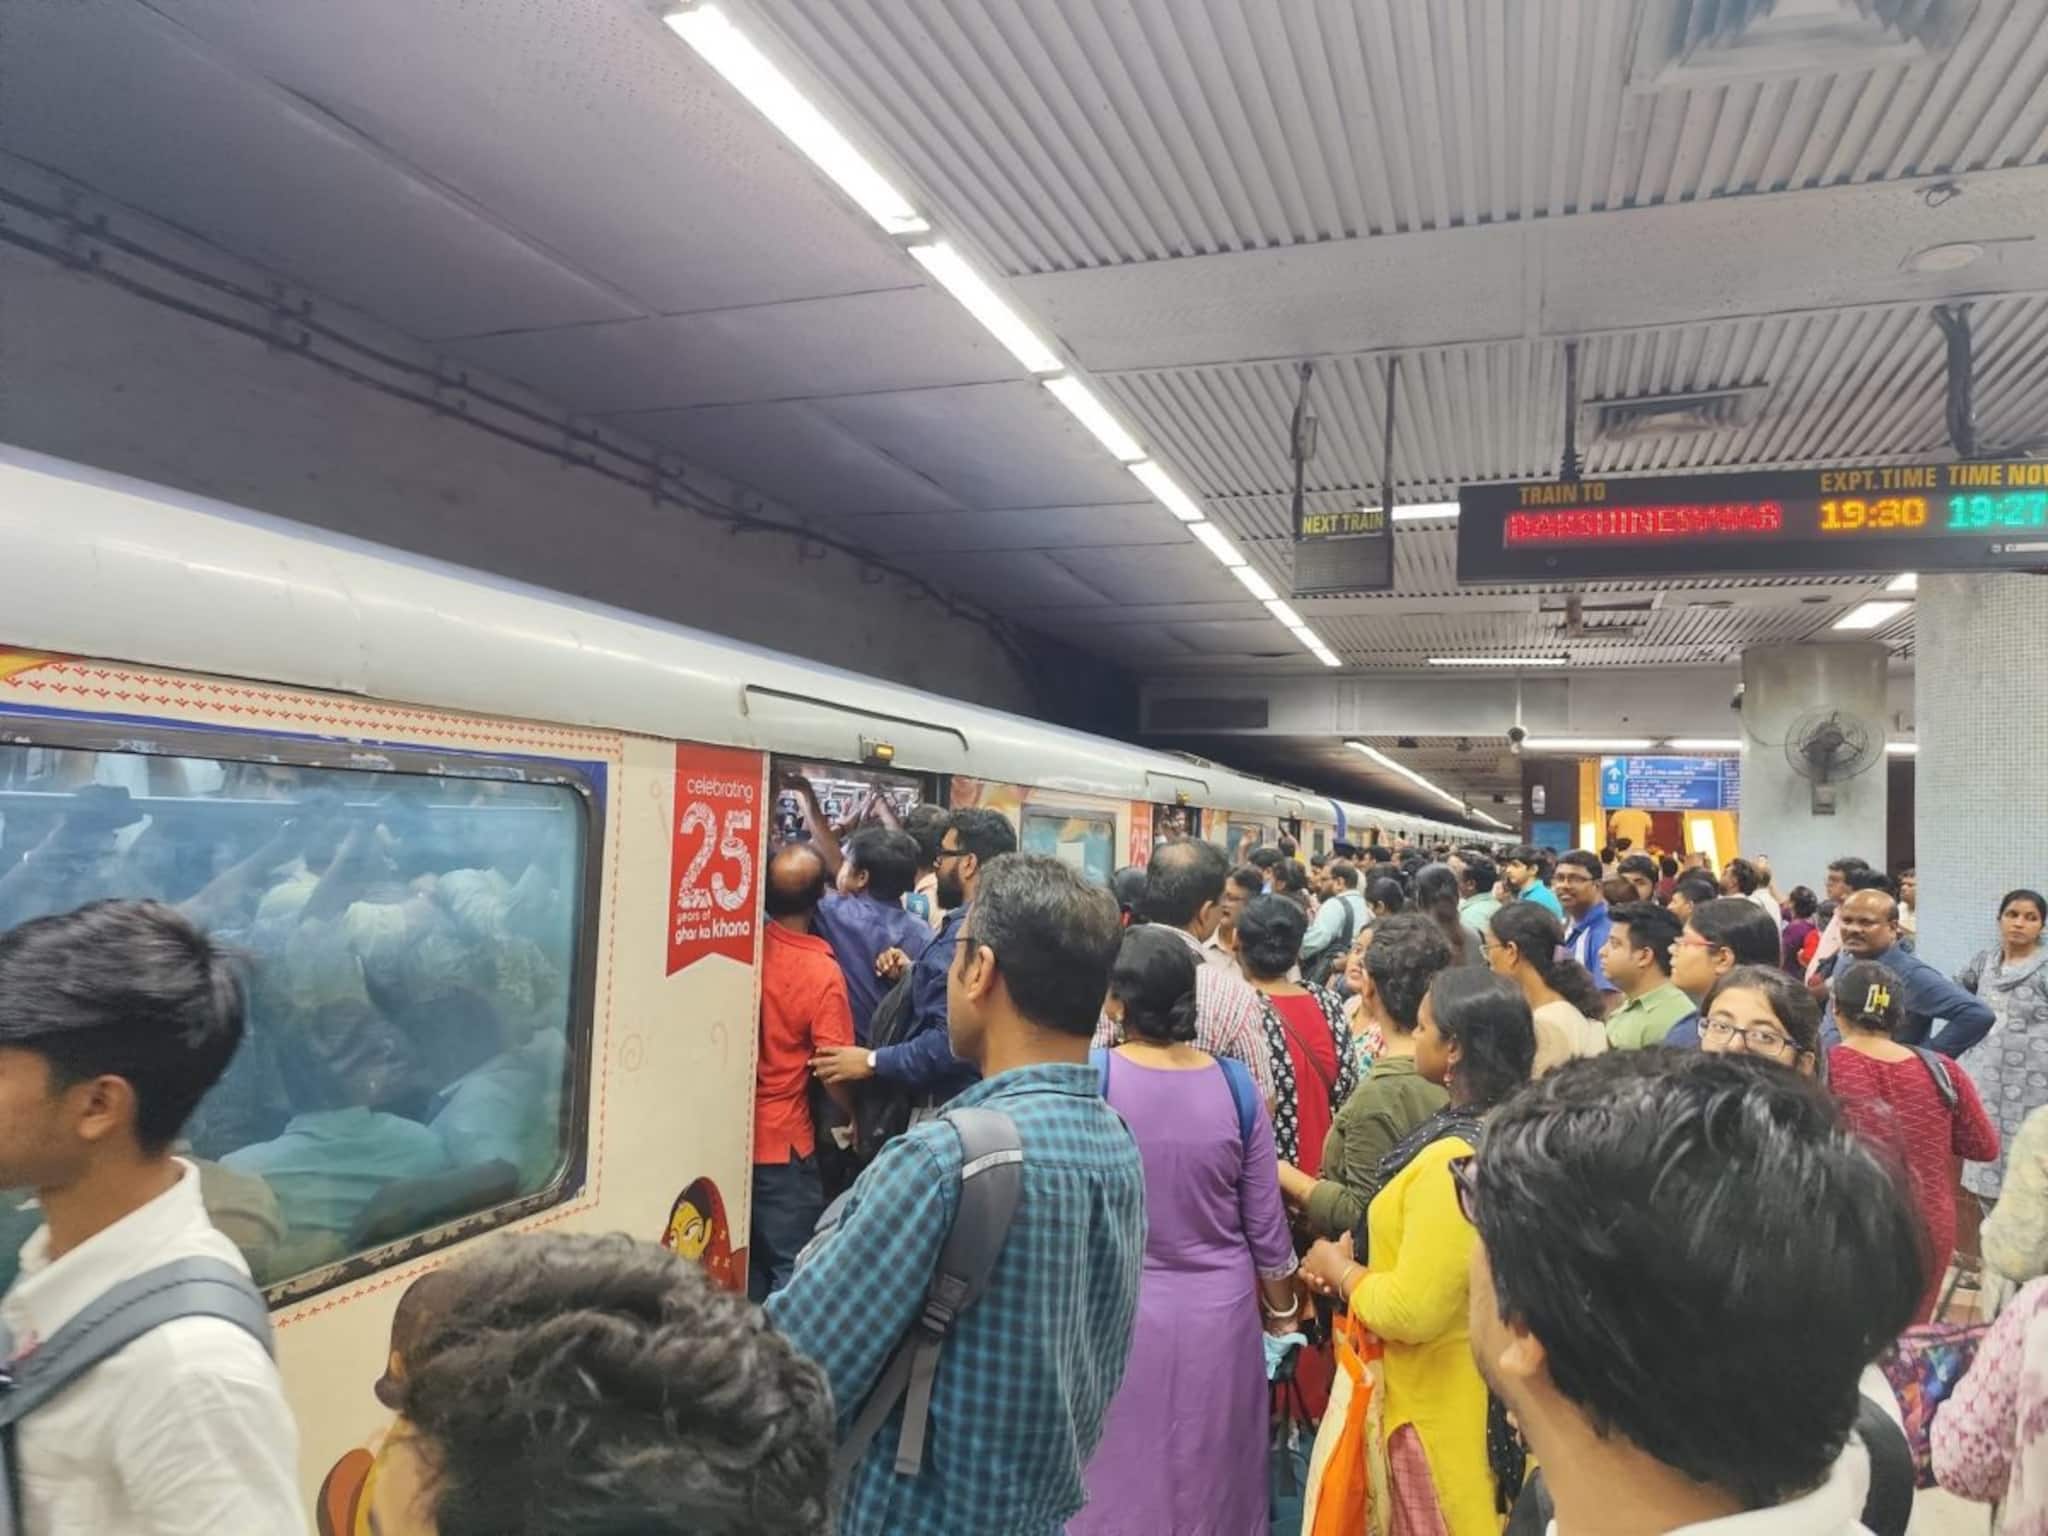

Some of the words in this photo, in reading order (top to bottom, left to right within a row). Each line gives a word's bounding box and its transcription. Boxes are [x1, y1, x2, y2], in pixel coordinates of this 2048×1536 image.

[1948, 464, 2002, 486] TIME
[1519, 484, 1577, 505] TRAIN
[1583, 482, 1606, 502] TO
[1302, 513, 1338, 534] NEXT
[1342, 510, 1383, 531] TRAIN
[1820, 496, 1927, 529] 19:30
[1948, 491, 2048, 528] 19:27
[687, 774, 754, 804] celebrating
[677, 801, 752, 912] 25
[675, 925, 697, 944] ghar
[698, 922, 711, 940] ka
[712, 917, 750, 937] khana
[676, 911, 700, 926] years
[702, 908, 711, 920] of
